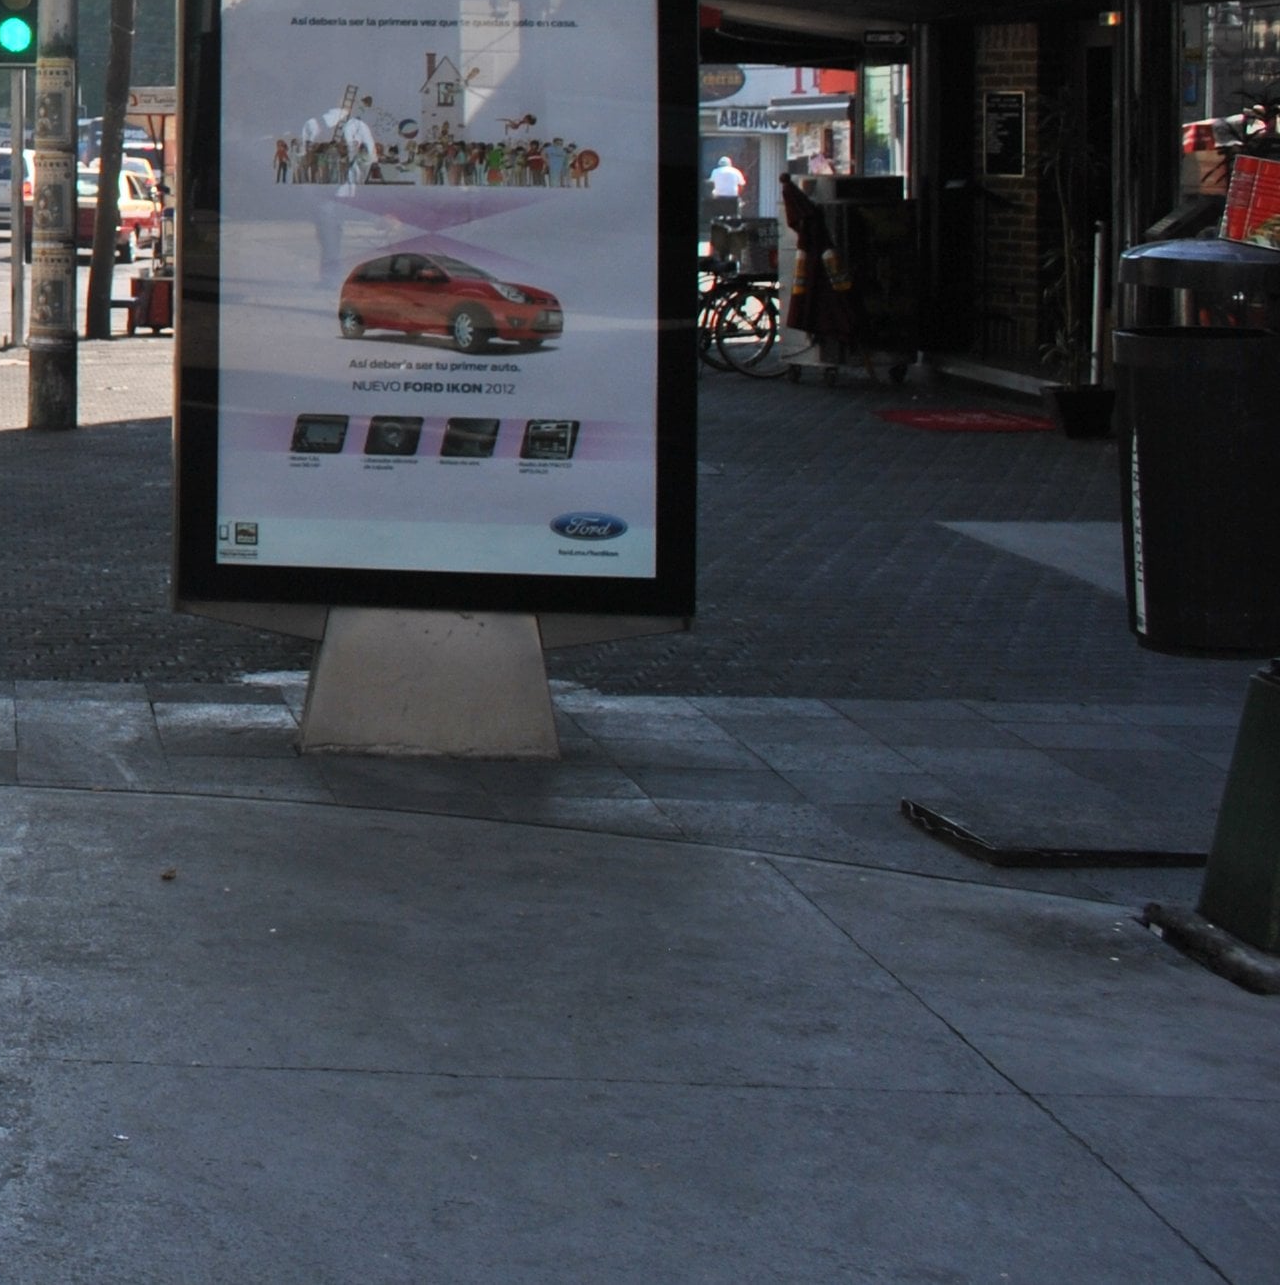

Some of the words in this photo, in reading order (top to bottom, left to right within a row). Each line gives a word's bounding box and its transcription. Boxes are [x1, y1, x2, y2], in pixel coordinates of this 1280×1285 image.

[348, 18, 365, 26] ser
[366, 16, 377, 26] la
[378, 17, 419, 29] primera
[420, 19, 438, 27] vez
[439, 19, 458, 29] que
[536, 19, 549, 27] en
[550, 19, 579, 27] casa.
[415, 362, 433, 371] ser
[435, 361, 448, 371] tu
[450, 360, 488, 374] primer
[490, 362, 521, 373] auto.
[352, 380, 401, 392] NUEVO
[403, 381, 444, 393] FORD
[446, 382, 483, 394] IKON
[484, 383, 517, 395] 2012
